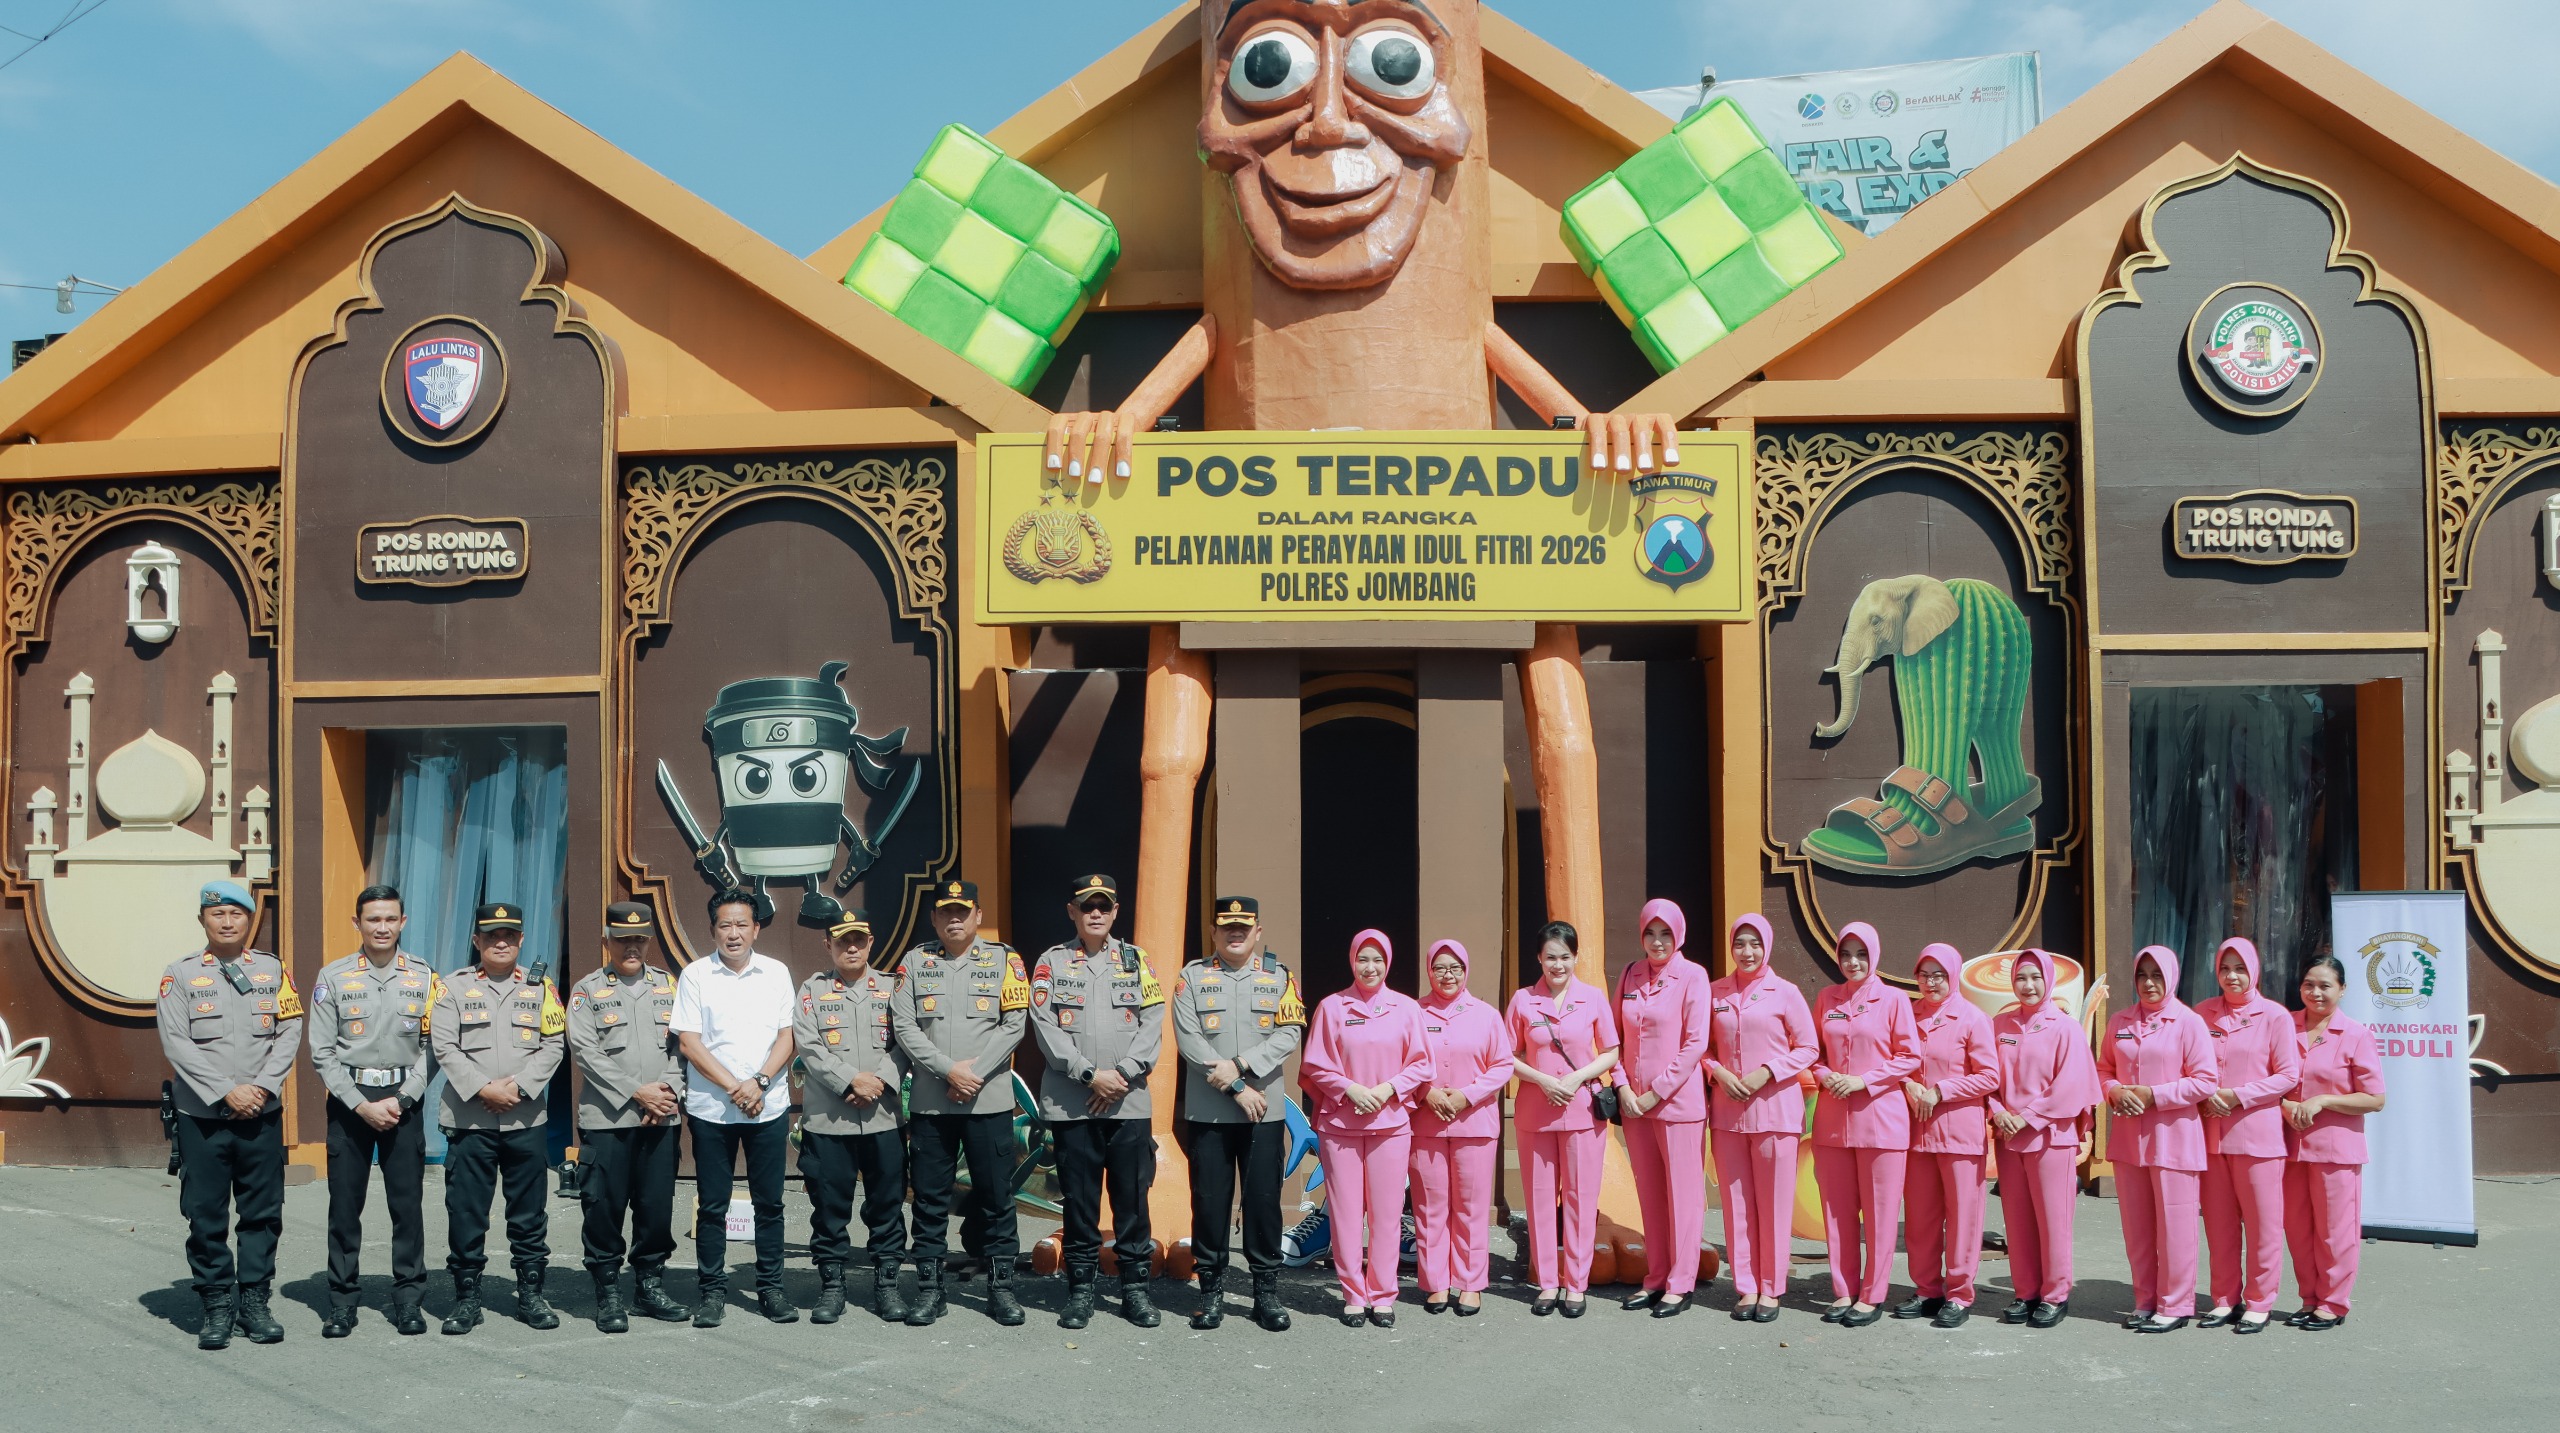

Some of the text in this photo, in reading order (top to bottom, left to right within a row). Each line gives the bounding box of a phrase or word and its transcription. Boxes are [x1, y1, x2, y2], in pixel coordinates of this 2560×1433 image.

[1905, 92, 1961, 106] BerAKHLAK
[1784, 129, 1950, 178] FAIR &
[1856, 168, 1975, 215] EXP
[2218, 305, 2298, 343] POLRES JOMBANG
[412, 343, 476, 361] LALU LINTAS
[2222, 363, 2263, 388] POLISI
[2268, 363, 2296, 386] BAIK
[1157, 455, 1579, 497] POS TERPADU
[1635, 476, 1712, 492] JAWA TIMUR
[1257, 511, 1478, 526] DALAM RANGKA
[2193, 507, 2334, 527] POS RONDA
[377, 531, 508, 552] POS RONDA
[2188, 528, 2344, 549] TRUNG TUNG
[1135, 534, 1607, 566] PELAYANAN PERAYAAN IDUL FITRI 2026
[372, 550, 517, 573] TRUNG TUNG
[1261, 571, 1476, 602] POLRES JOMBANG
[2372, 932, 2424, 944] BHAYANGKARI
[970, 971, 1000, 979] POLRI
[251, 987, 277, 995] POLRI
[341, 992, 368, 1001] ANJAR
[399, 990, 424, 999] POLRI
[1200, 986, 1223, 994] ARDI
[1253, 986, 1278, 995] POLRI
[464, 1002, 487, 1010] RIZAL
[513, 1001, 540, 1010] POLRI
[593, 1000, 622, 1012] QOYUM
[820, 1003, 844, 1012] RUDI
[871, 1002, 888, 1010] POL
[2363, 1023, 2458, 1035] AYANGKARI
[2375, 1038, 2453, 1058] EDULI
